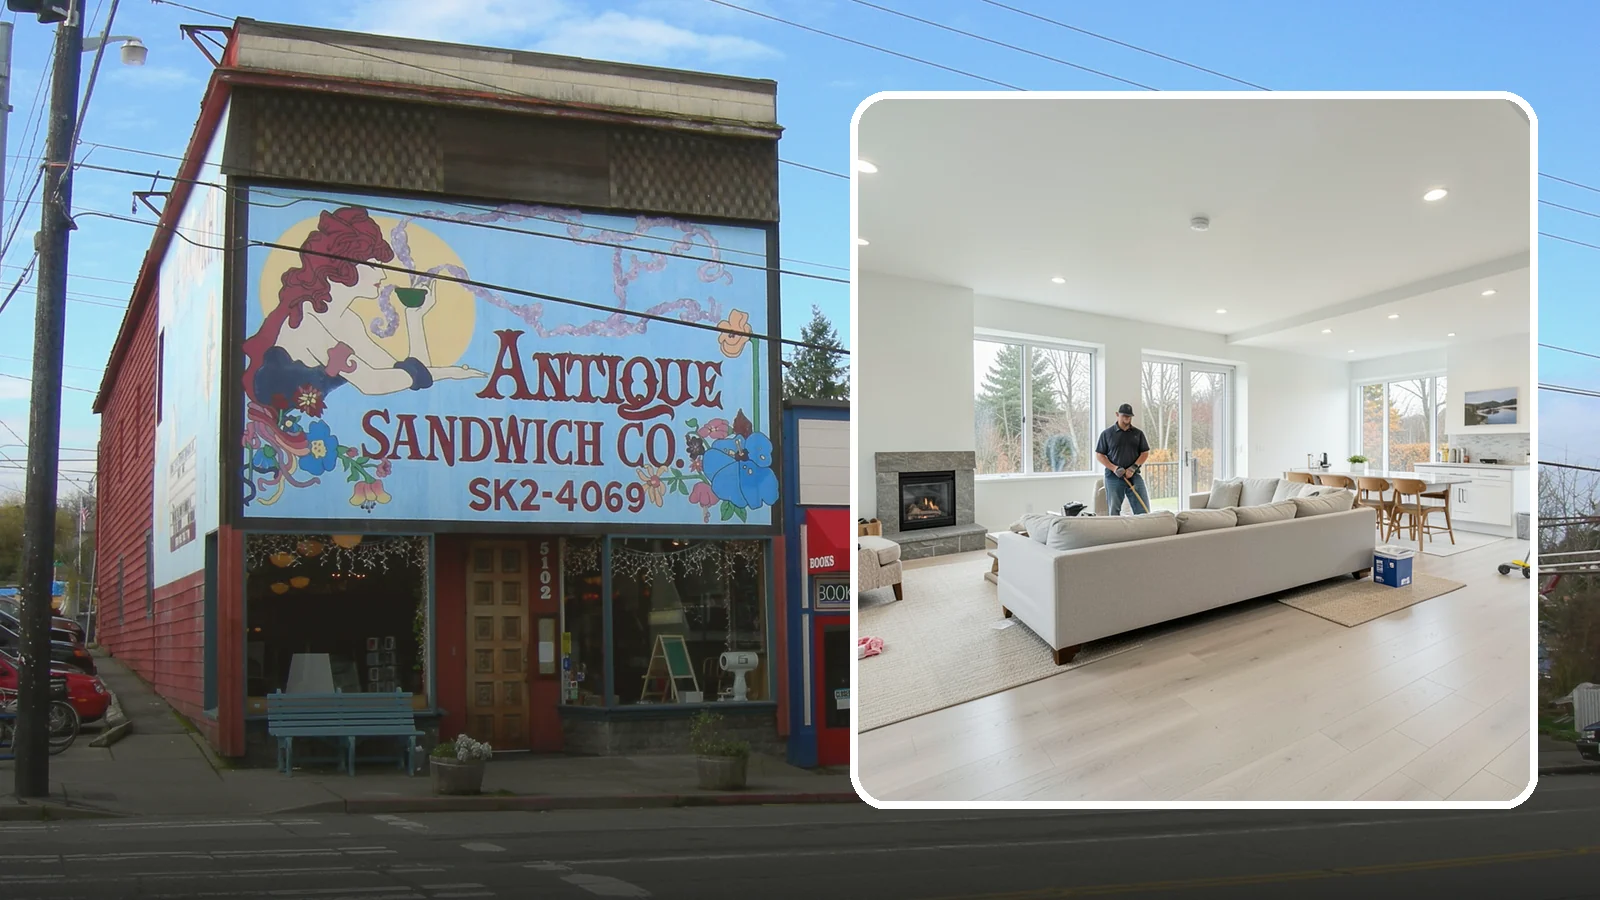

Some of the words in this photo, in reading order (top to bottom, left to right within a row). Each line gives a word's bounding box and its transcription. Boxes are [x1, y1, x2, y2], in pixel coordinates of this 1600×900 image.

[475, 330, 722, 421] ANTIQUE
[361, 410, 604, 467] SANDWICH
[617, 422, 685, 469] CO.
[468, 478, 645, 513] SK2-4069
[540, 542, 552, 599] 5102
[809, 555, 835, 569] BOOKS
